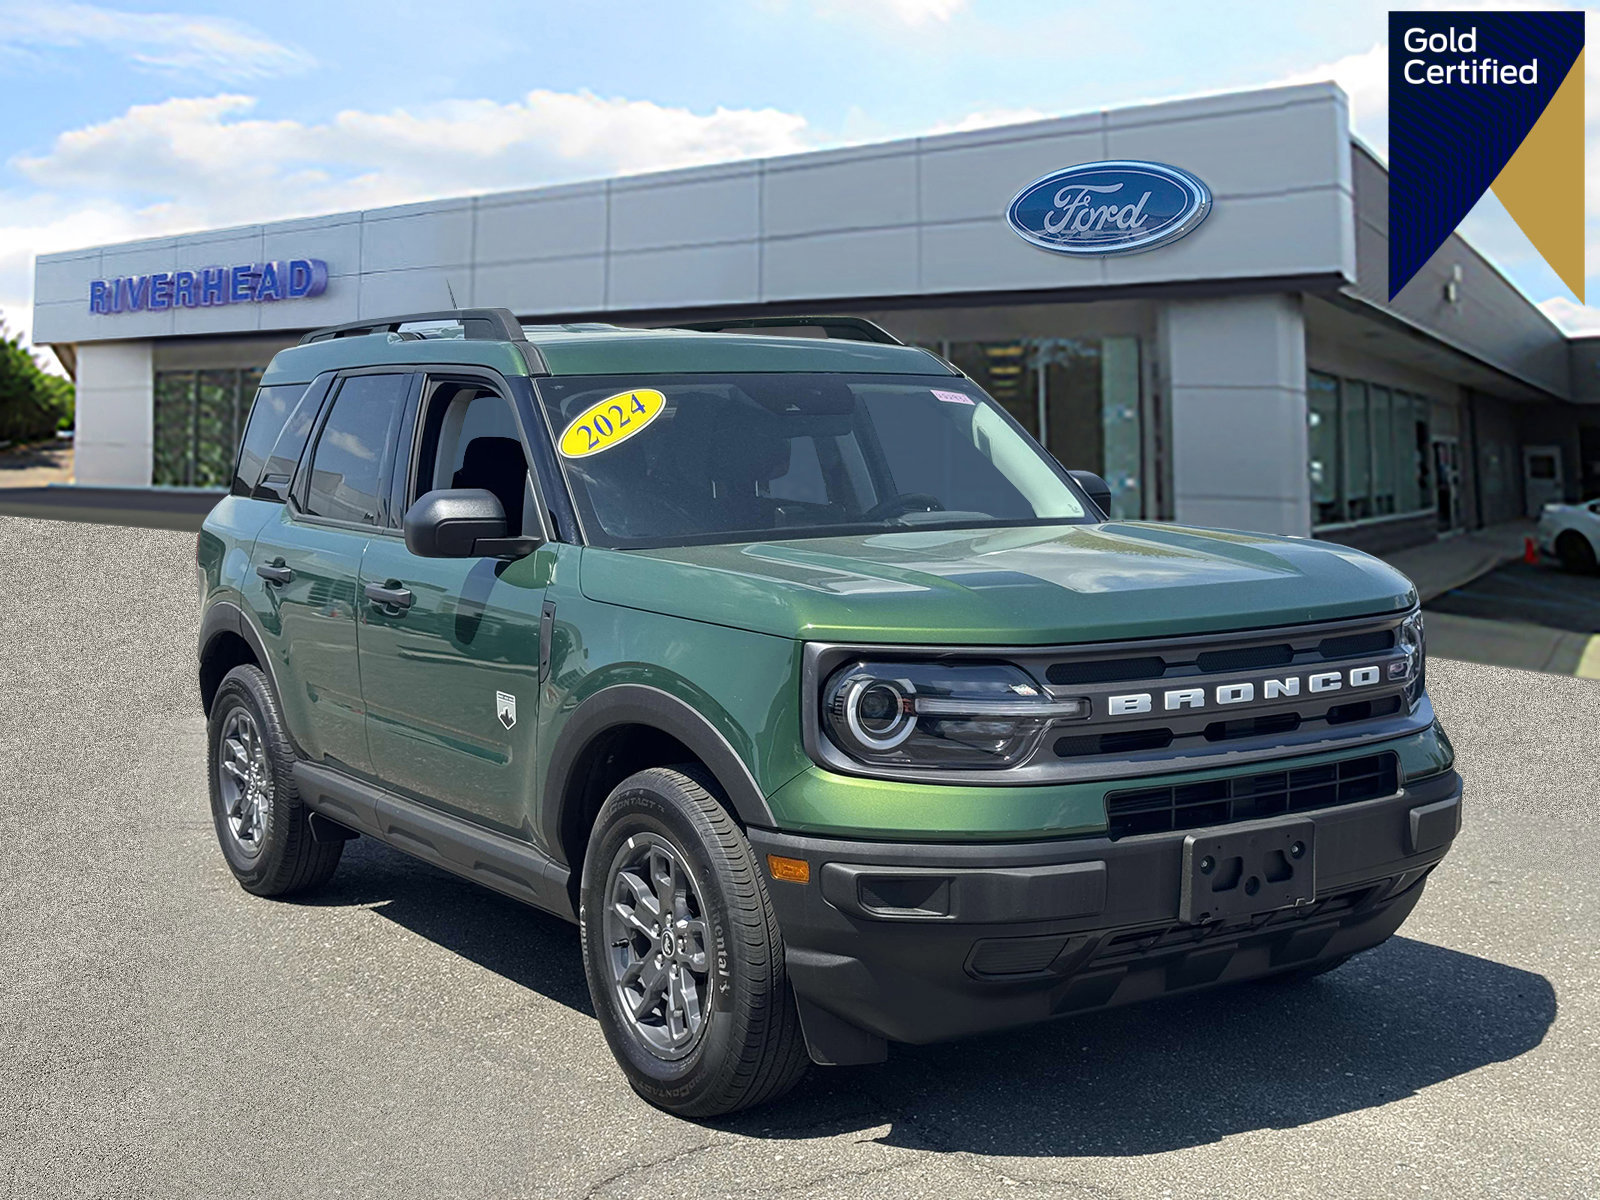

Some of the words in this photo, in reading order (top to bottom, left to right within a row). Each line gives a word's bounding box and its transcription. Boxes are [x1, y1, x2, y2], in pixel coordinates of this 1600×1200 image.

[1044, 182, 1152, 233] Ford
[89, 259, 317, 315] RIVERHEAD
[577, 394, 646, 450] 2024
[1109, 665, 1379, 716] BRONCO
